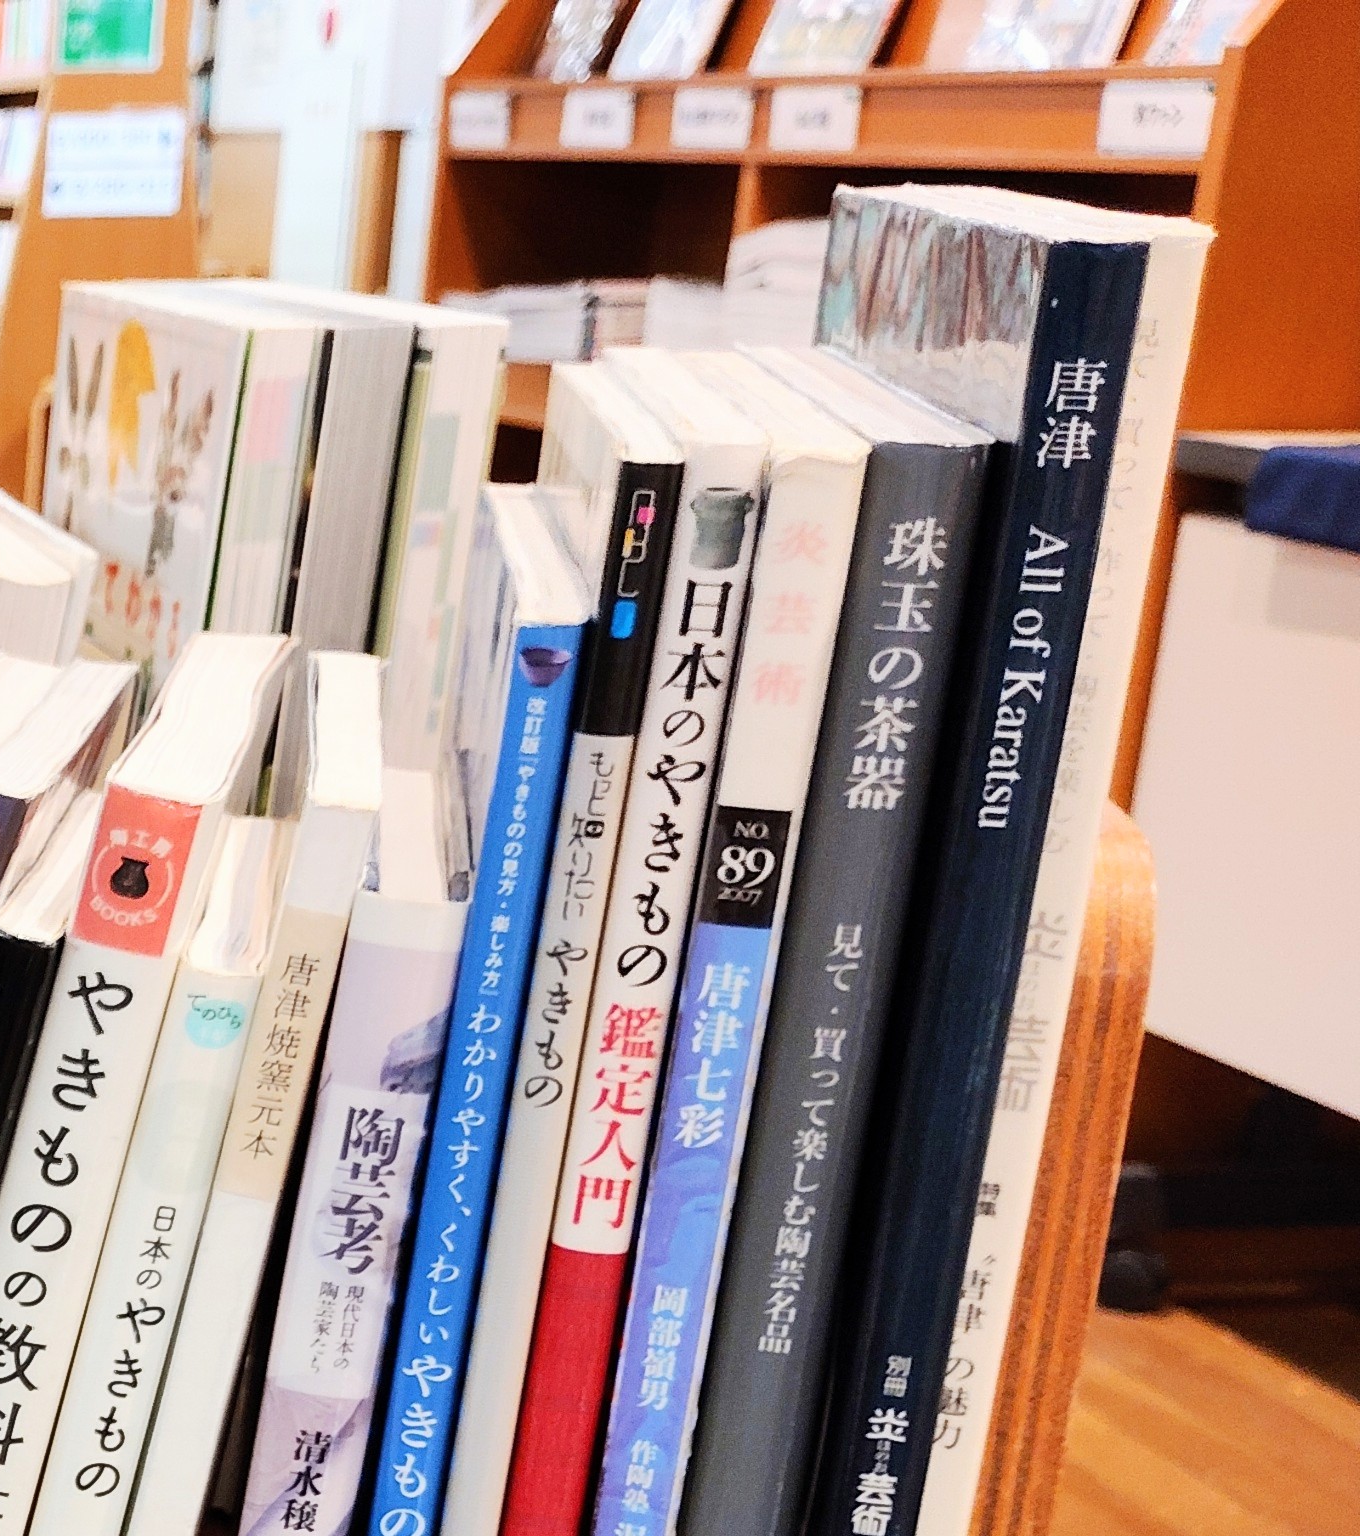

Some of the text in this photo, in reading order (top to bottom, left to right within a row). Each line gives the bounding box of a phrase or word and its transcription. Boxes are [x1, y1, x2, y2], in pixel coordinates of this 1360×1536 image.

[1036, 357, 1109, 470] 唐津
[842, 516, 948, 811] 珠玉の茶器
[977, 525, 1070, 830] All of Karatsu
[89, 895, 158, 927] BOOKS
[571, 579, 732, 1231] 日本のやきもの 鑑定入門
[717, 845, 775, 888] 89
[239, 954, 320, 1160] 唐津焼窯元本
[524, 940, 588, 1109] やきもの
[673, 962, 749, 1149] 唐津七彩
[318, 1105, 406, 1275] 陶芸考
[76, 1206, 177, 1498] 日本のやきもの
[333, 1285, 365, 1370] 現代日本の
